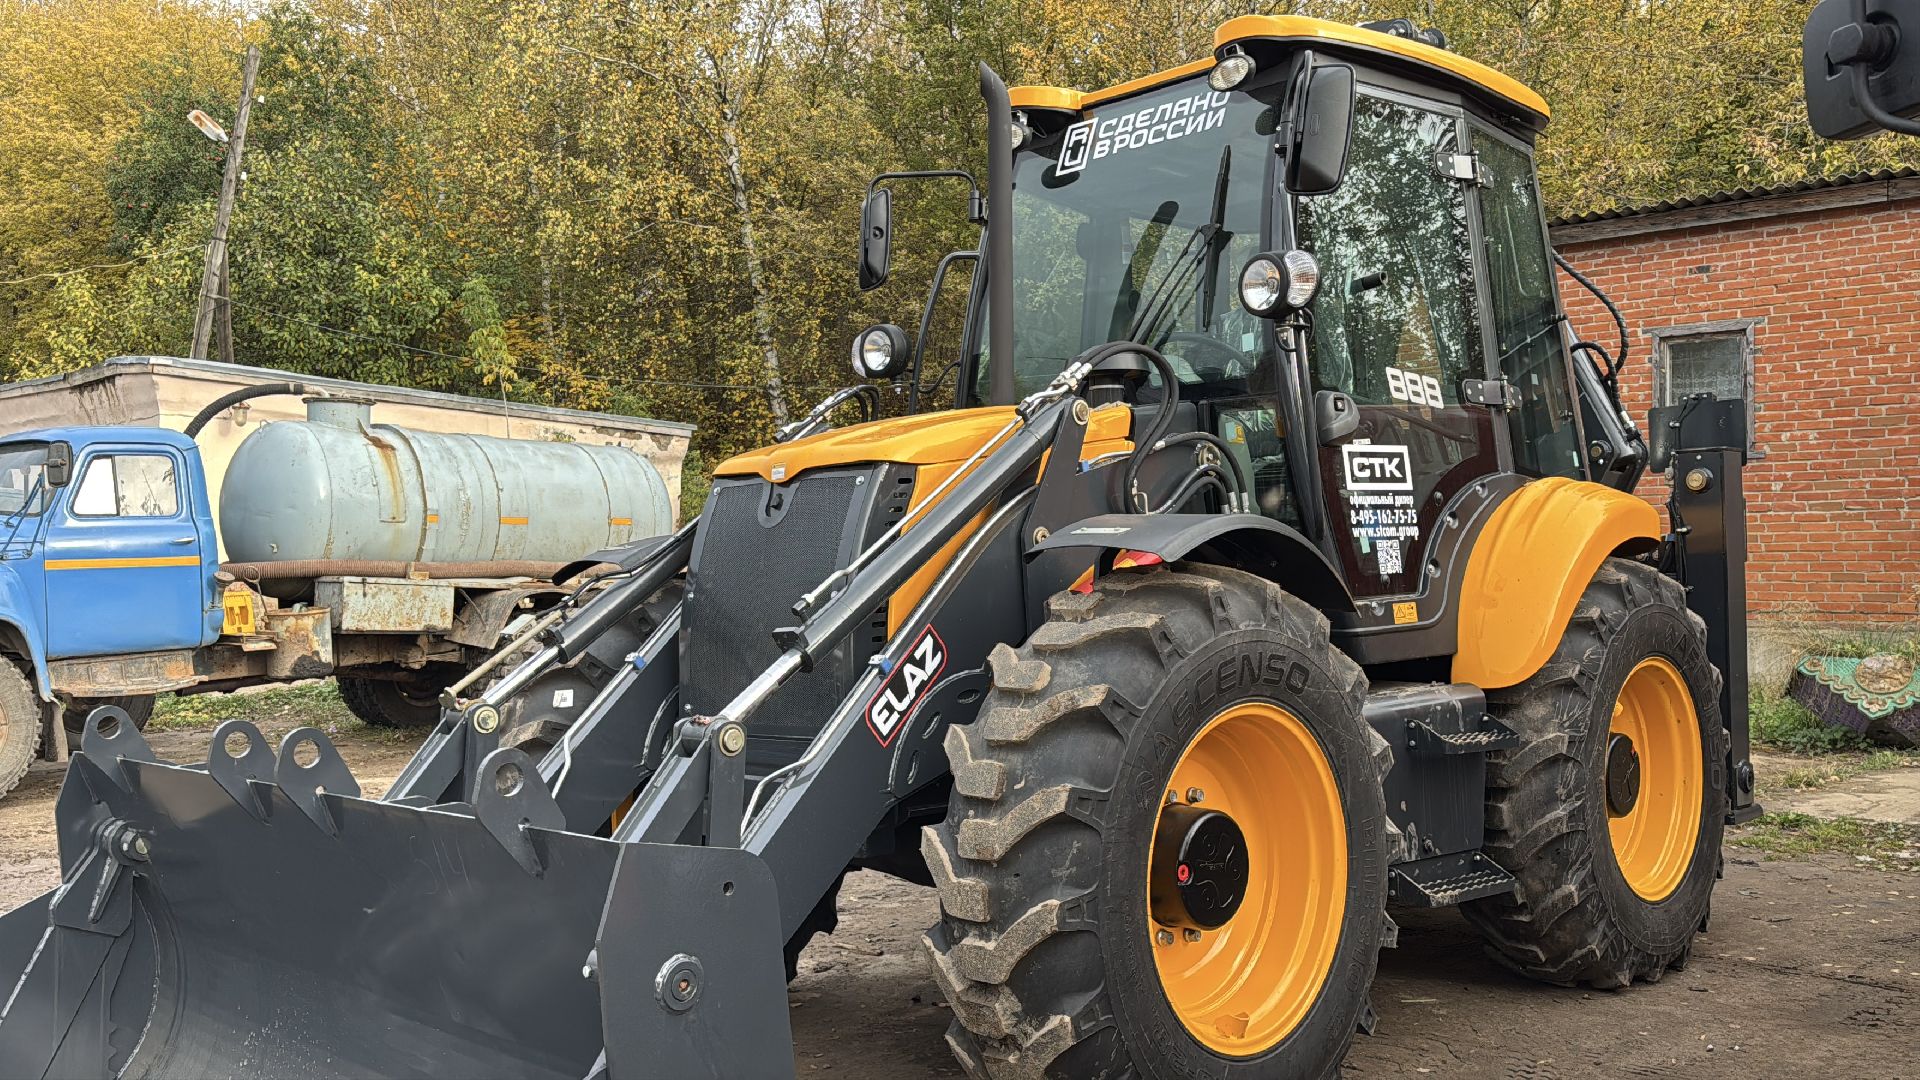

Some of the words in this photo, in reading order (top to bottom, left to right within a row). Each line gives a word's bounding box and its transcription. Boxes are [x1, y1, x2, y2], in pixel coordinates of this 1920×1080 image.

[1098, 92, 1231, 138] СДЕЛАНО
[1112, 107, 1227, 155] РОССИИ
[1386, 366, 1444, 409] 888
[1352, 457, 1403, 478] СТК
[1350, 509, 1418, 524] 8-495-162-75-75
[871, 633, 942, 737] ELAZ
[1153, 651, 1310, 777] ASCENSO
